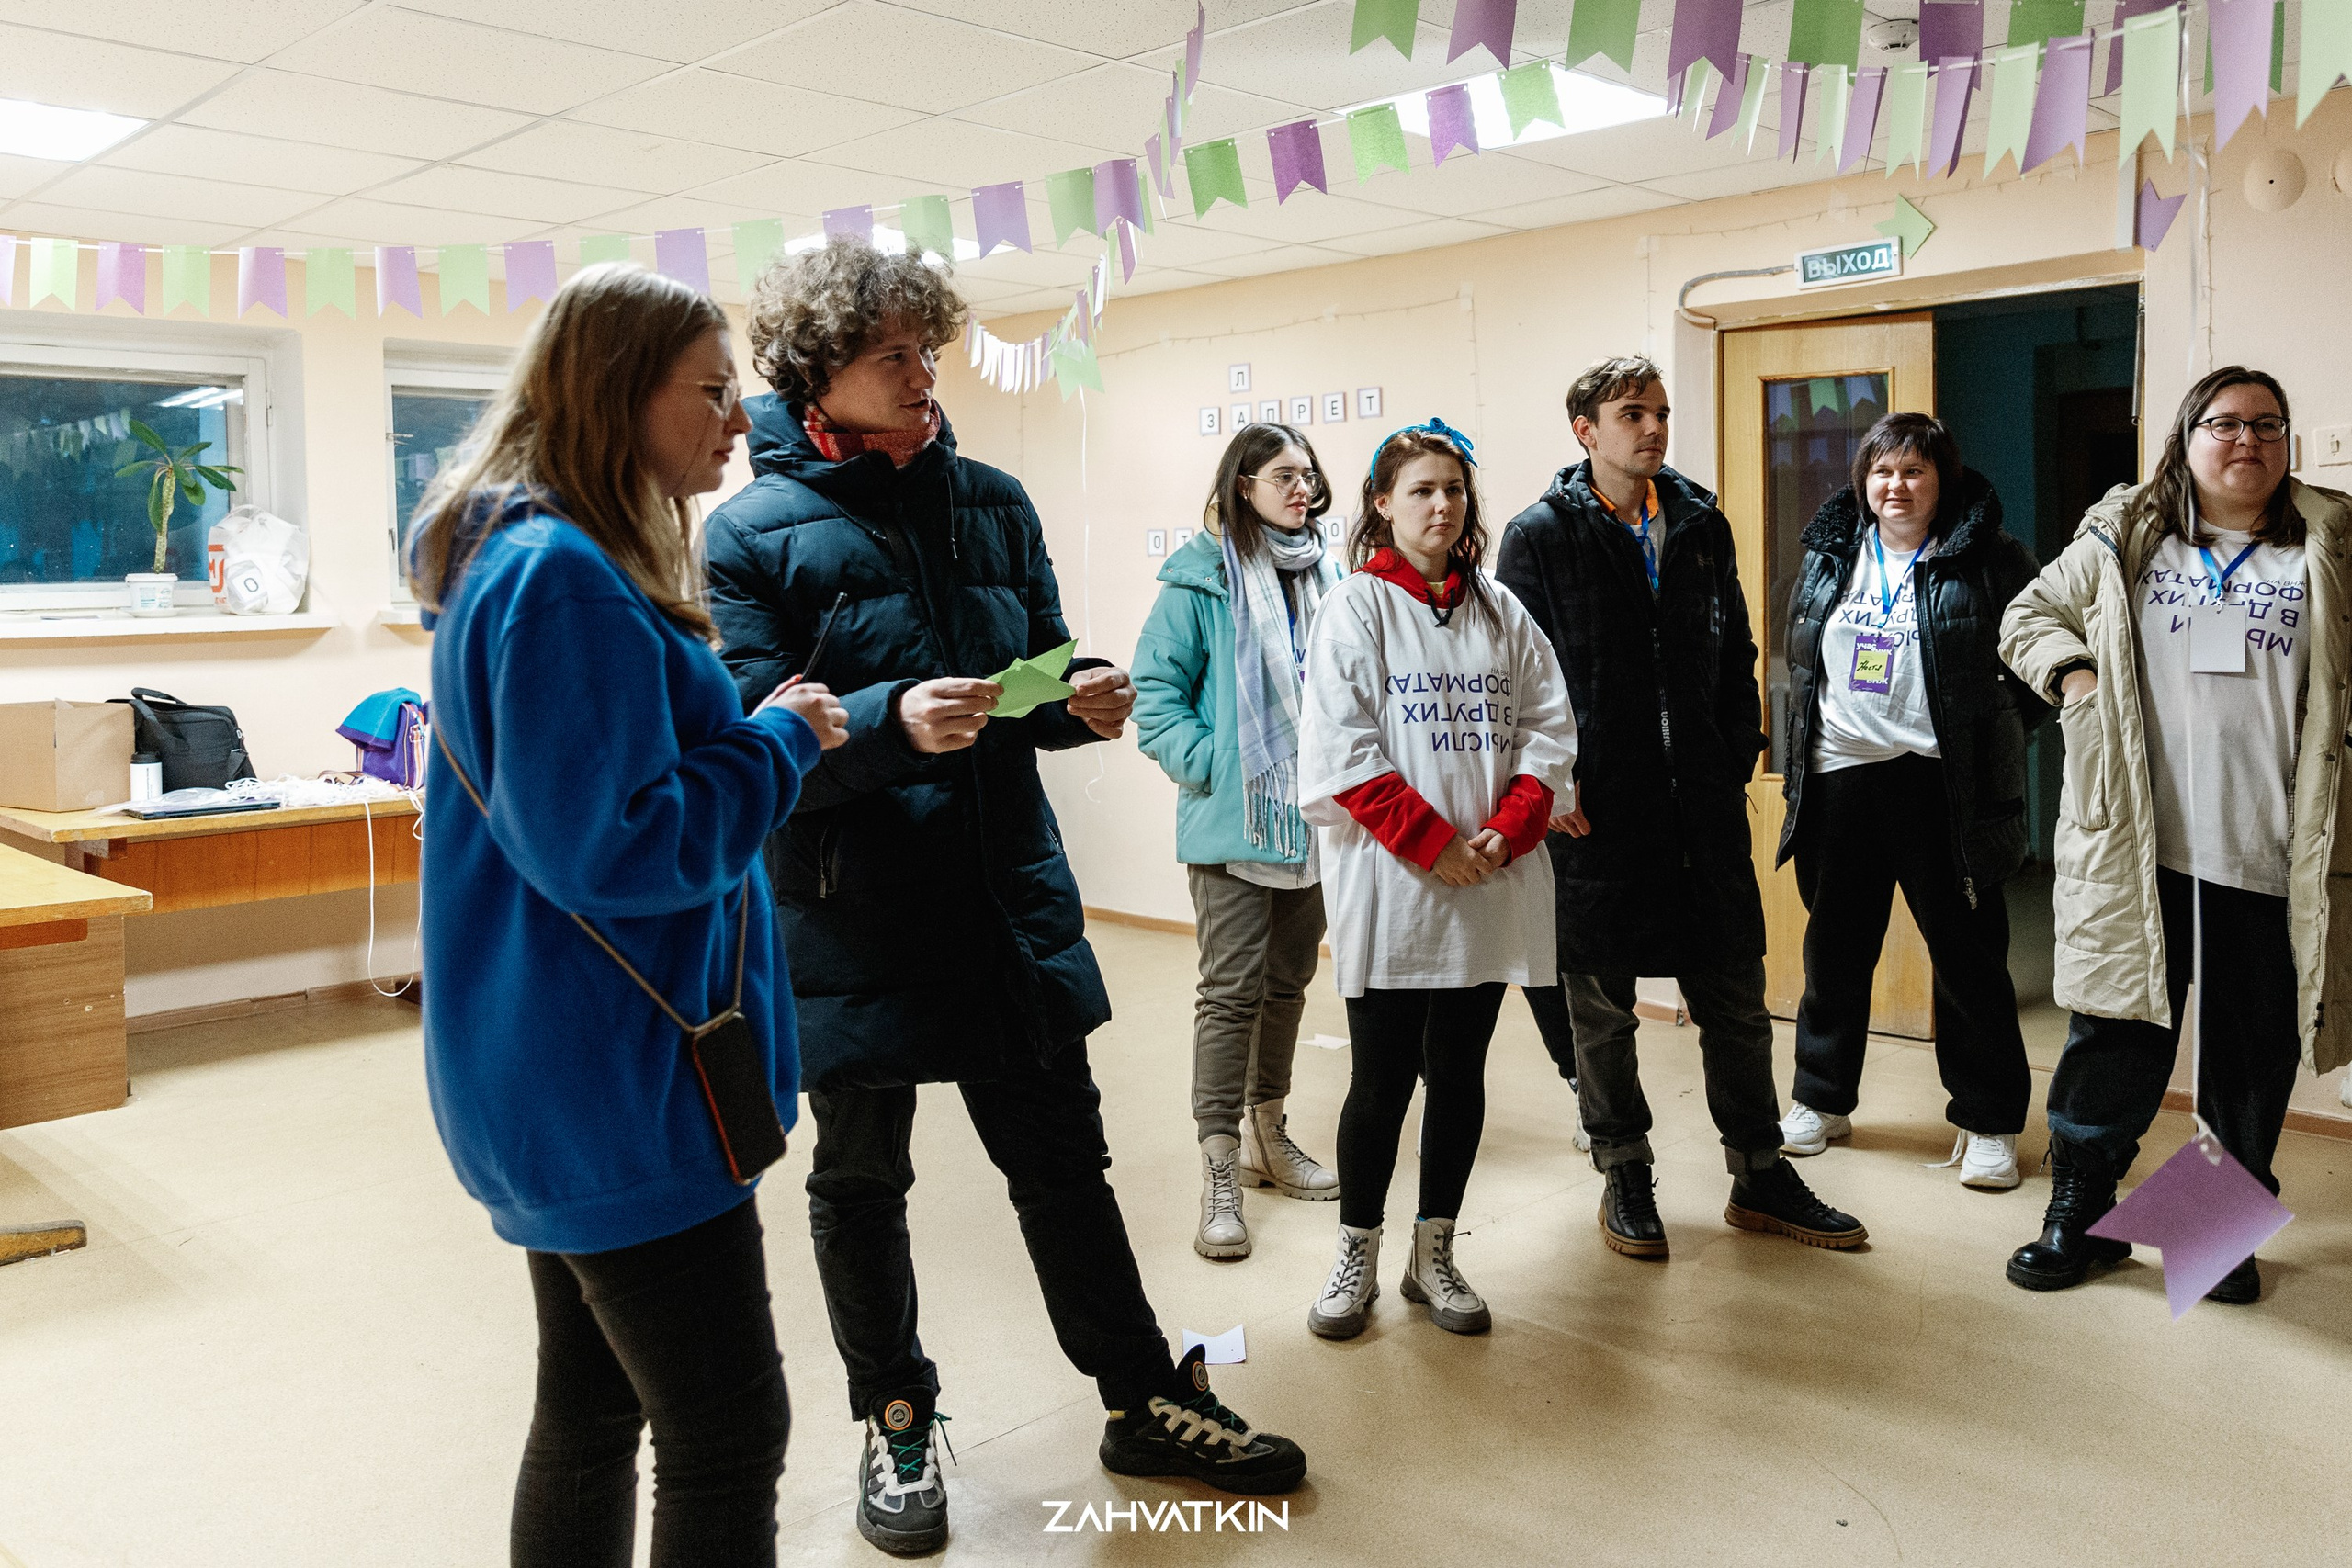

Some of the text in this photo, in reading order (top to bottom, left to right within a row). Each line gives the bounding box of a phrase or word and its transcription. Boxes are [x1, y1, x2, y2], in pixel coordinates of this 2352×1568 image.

[1807, 247, 1890, 279] ВЫХОД
[1235, 371, 1245, 386] Л
[1207, 395, 1374, 429] ЗАПРЕТ
[2280, 609, 2300, 628] В
[1401, 698, 1499, 724] ДРУГИХ
